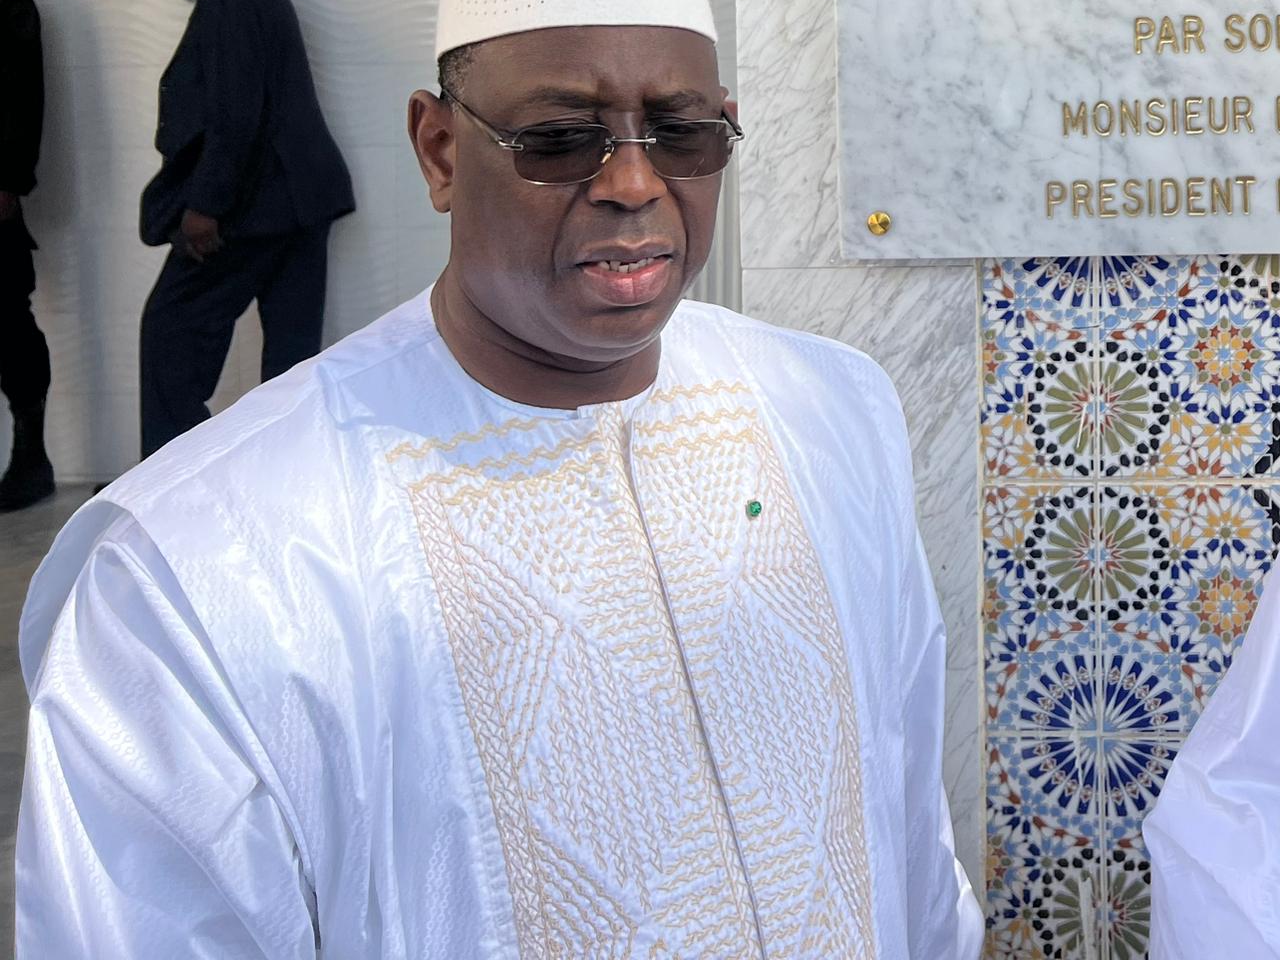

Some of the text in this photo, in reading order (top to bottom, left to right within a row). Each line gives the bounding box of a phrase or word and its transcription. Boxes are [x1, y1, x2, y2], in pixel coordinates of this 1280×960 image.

[1134, 15, 1206, 55] PAR
[1062, 96, 1256, 137] MONSIEUR
[1046, 176, 1257, 219] PRESIDENT
